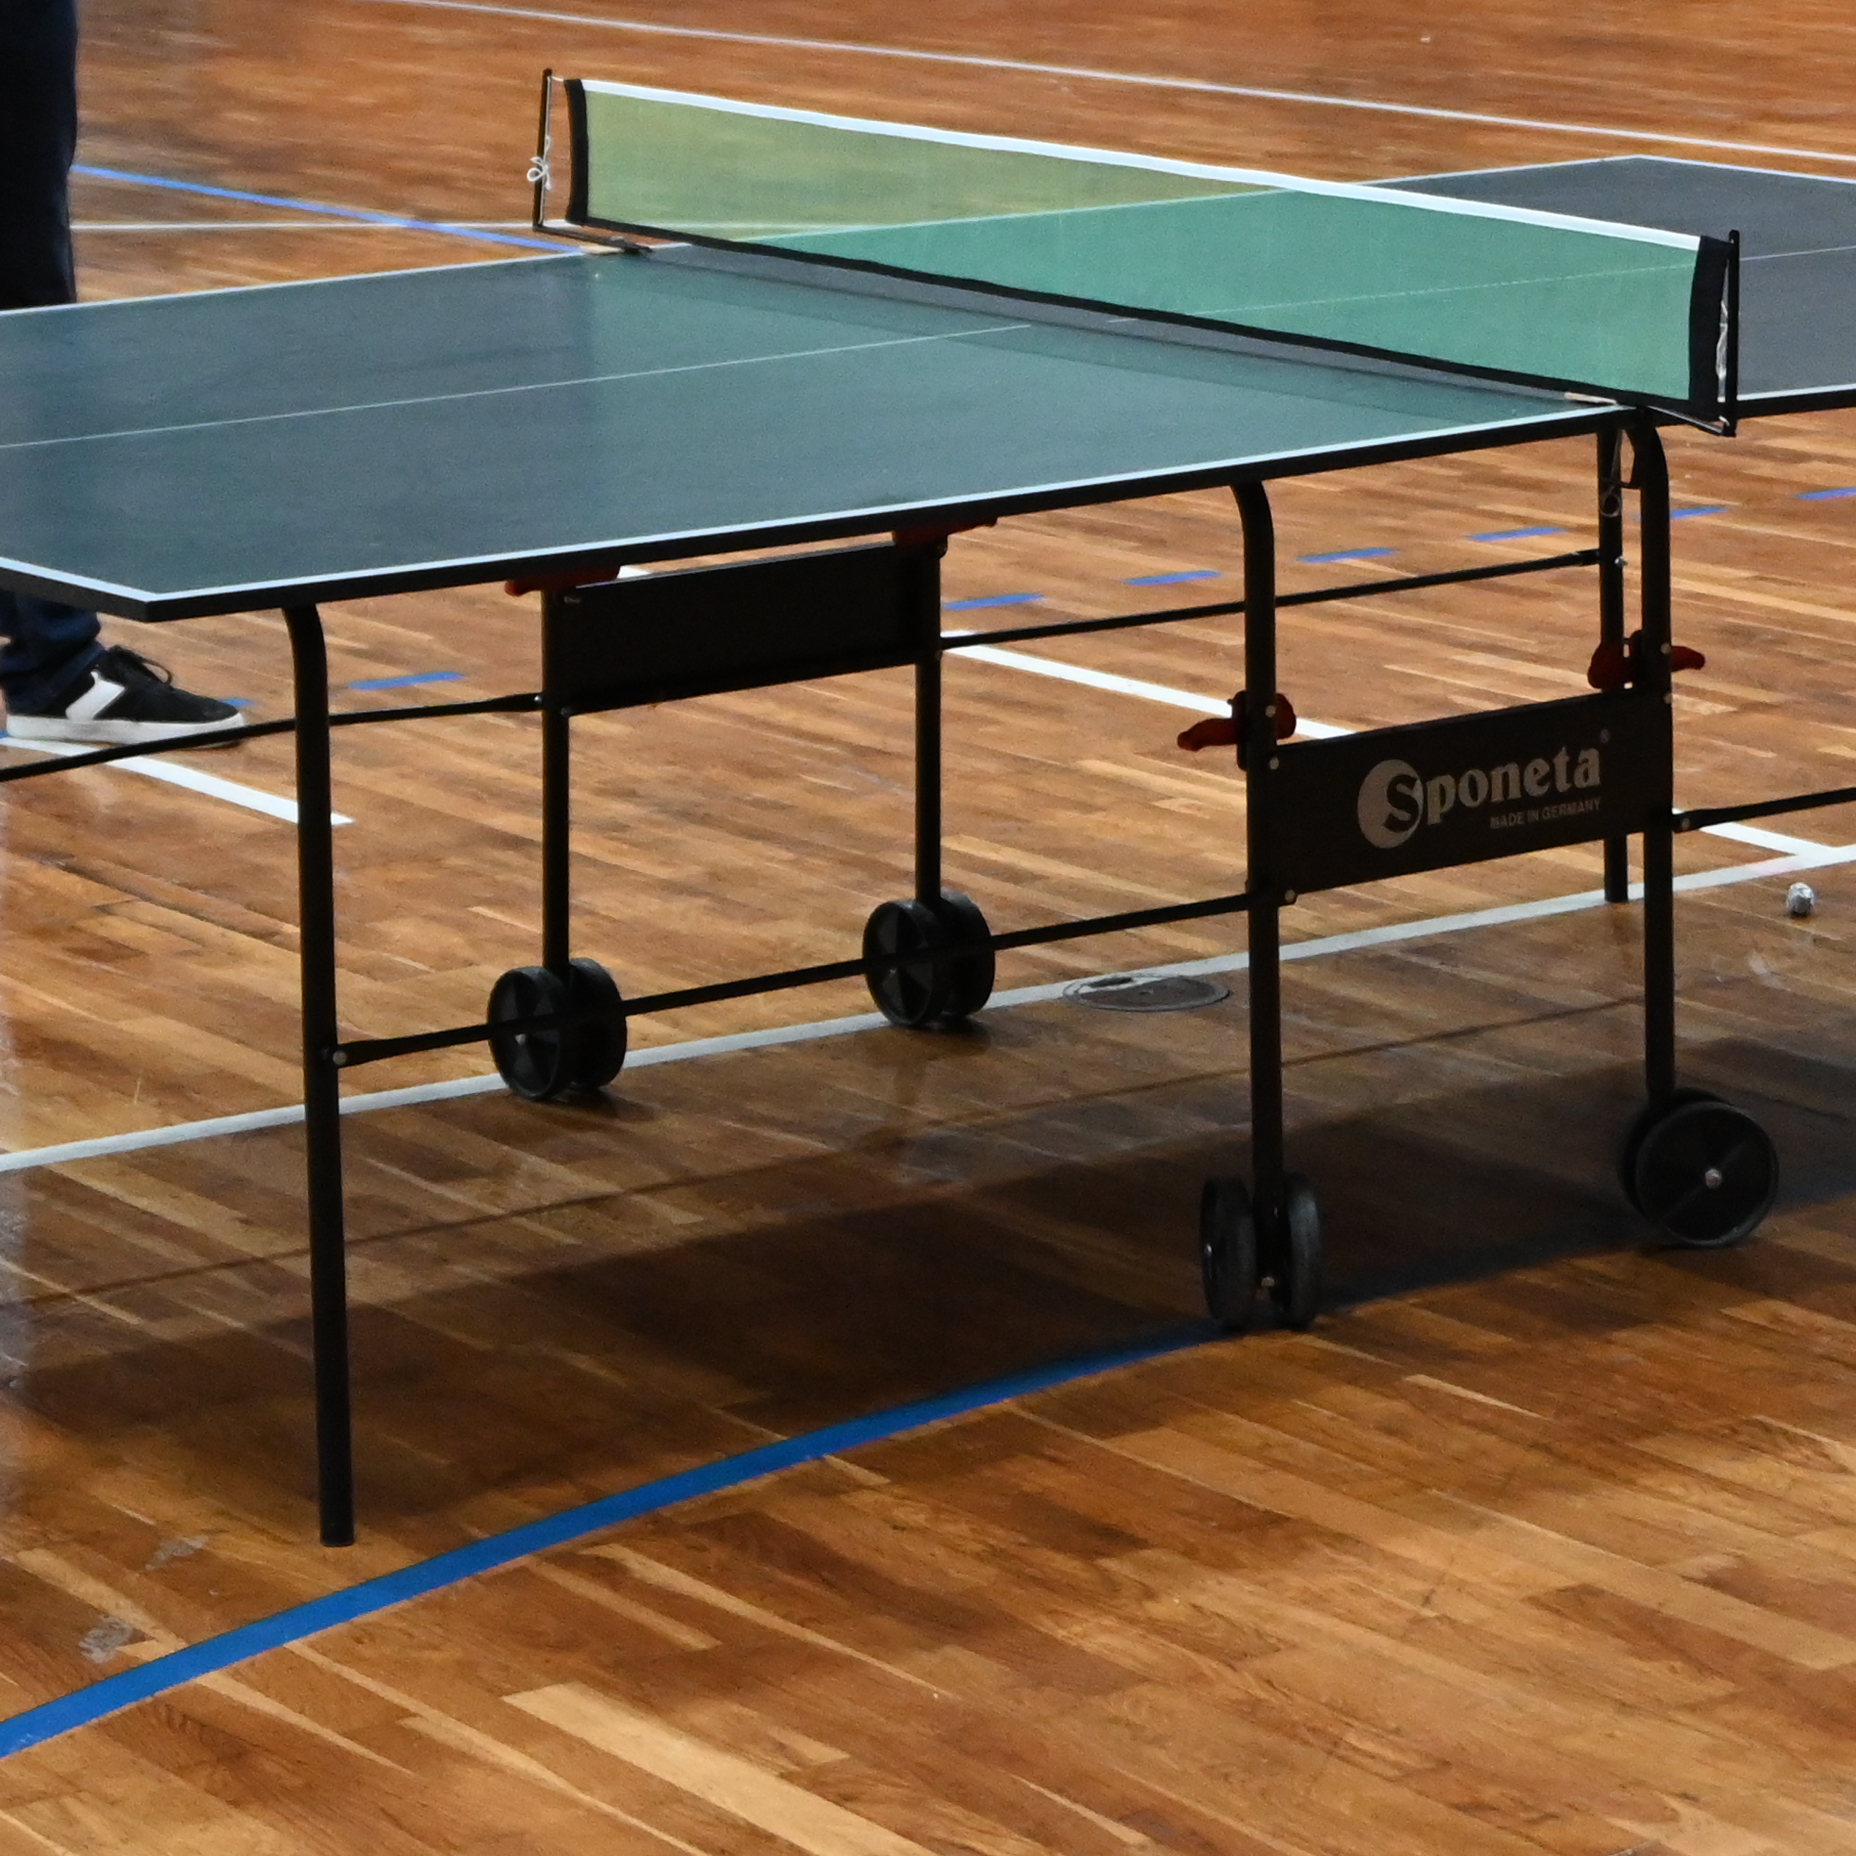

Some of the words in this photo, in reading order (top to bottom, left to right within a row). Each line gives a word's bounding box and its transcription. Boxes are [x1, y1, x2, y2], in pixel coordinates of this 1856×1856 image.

[1374, 744, 1602, 836] Sponeta
[1489, 811, 1525, 830] MADE
[1527, 809, 1539, 823] IN
[1541, 796, 1603, 820] GERMANY
